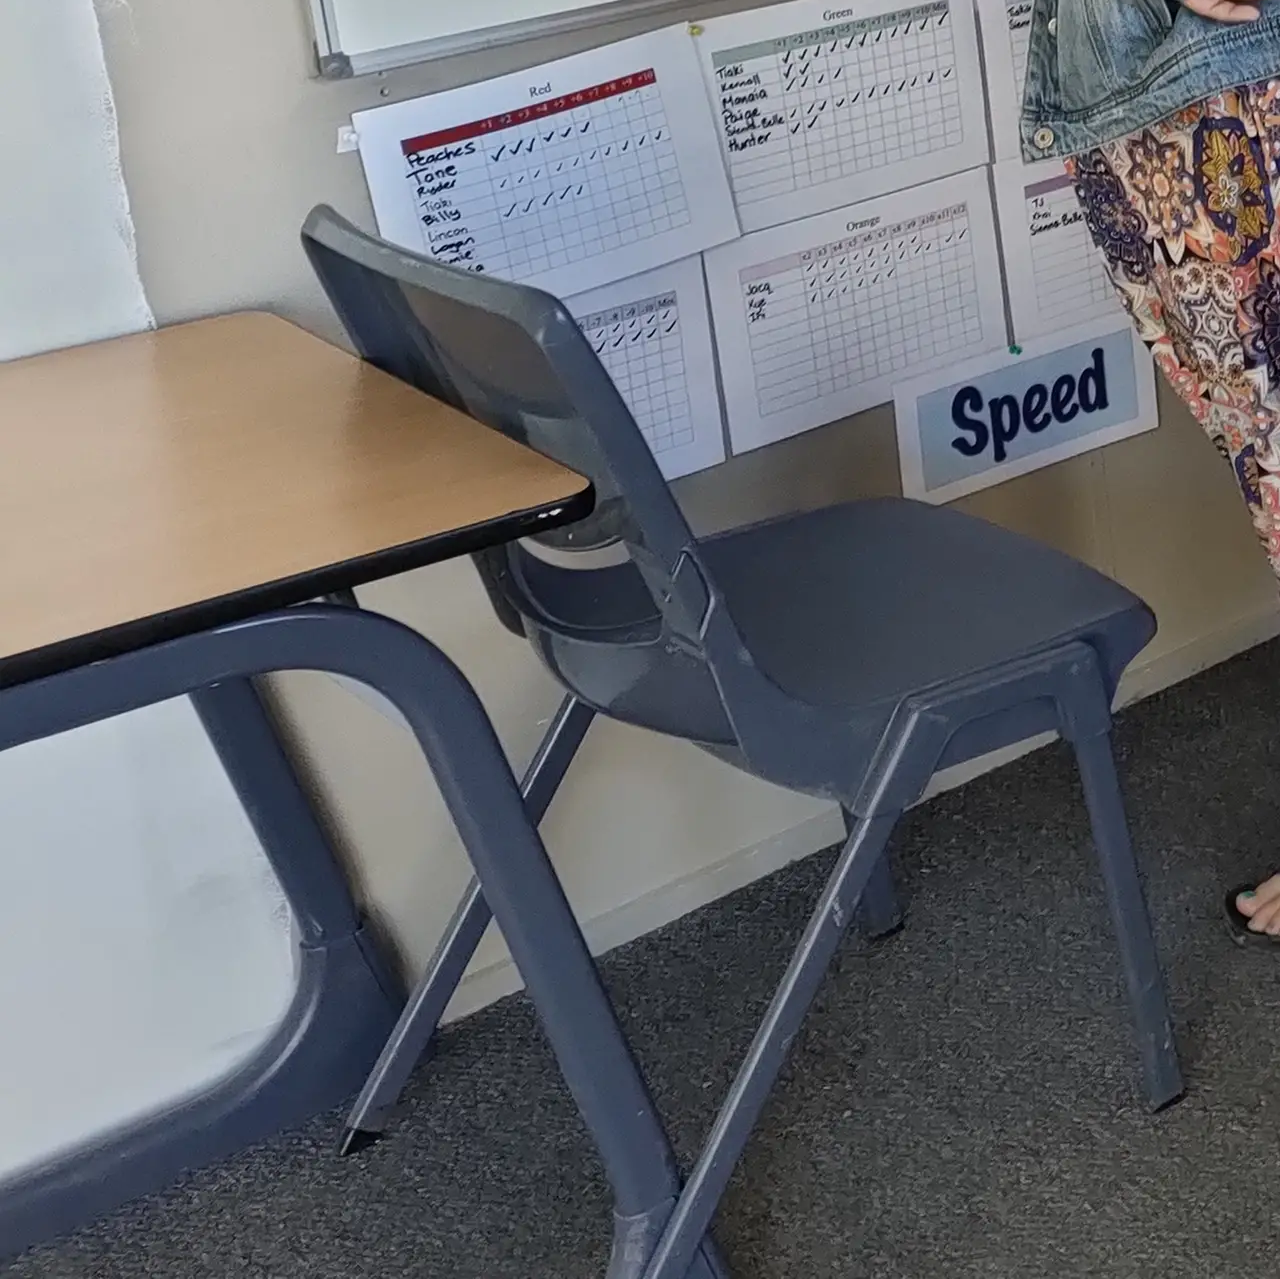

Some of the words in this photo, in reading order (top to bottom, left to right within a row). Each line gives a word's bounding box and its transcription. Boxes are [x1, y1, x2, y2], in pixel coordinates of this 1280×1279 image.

[822, 7, 853, 22] Green
[528, 82, 552, 98] Red
[406, 142, 476, 168] Peaches
[421, 209, 462, 227] Billy
[846, 215, 881, 232] Orange
[951, 347, 1110, 463] Speed
